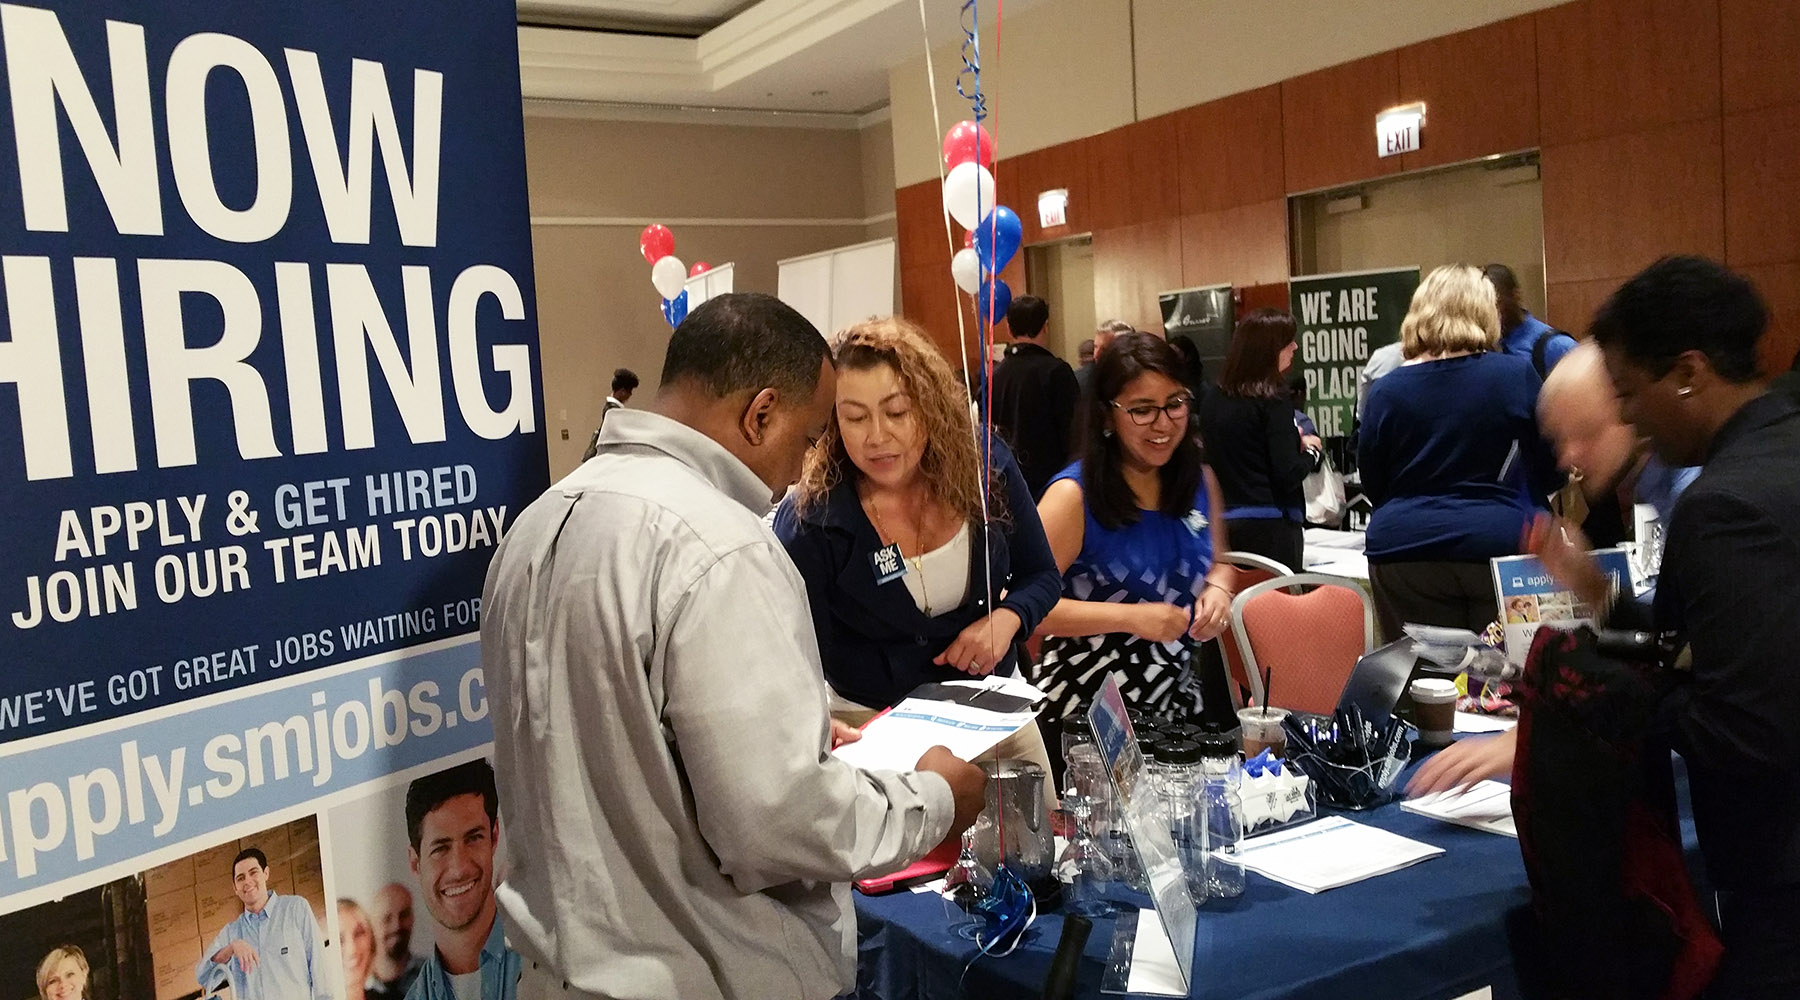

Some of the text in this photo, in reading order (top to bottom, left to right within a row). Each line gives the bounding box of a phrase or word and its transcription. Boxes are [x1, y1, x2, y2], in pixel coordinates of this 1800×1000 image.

[0, 3, 443, 247] NOW
[1386, 126, 1412, 154] EXIT
[1300, 286, 1379, 325] WE ARE
[0, 255, 535, 481] HIRING
[1302, 326, 1368, 364] GOING
[1307, 405, 1344, 437] ARE
[54, 464, 477, 562] APPLY & GET HIRED
[11, 505, 507, 629] JOIN OUR TEAM TODAY
[874, 545, 897, 566] ASK
[879, 558, 899, 576] ME
[108, 666, 163, 706] GOT
[174, 645, 260, 690] GREAT
[269, 629, 335, 669] JOBS
[340, 607, 436, 651] WAITING
[443, 598, 482, 628] FOR
[0, 668, 490, 879] pply.smjobs.c
